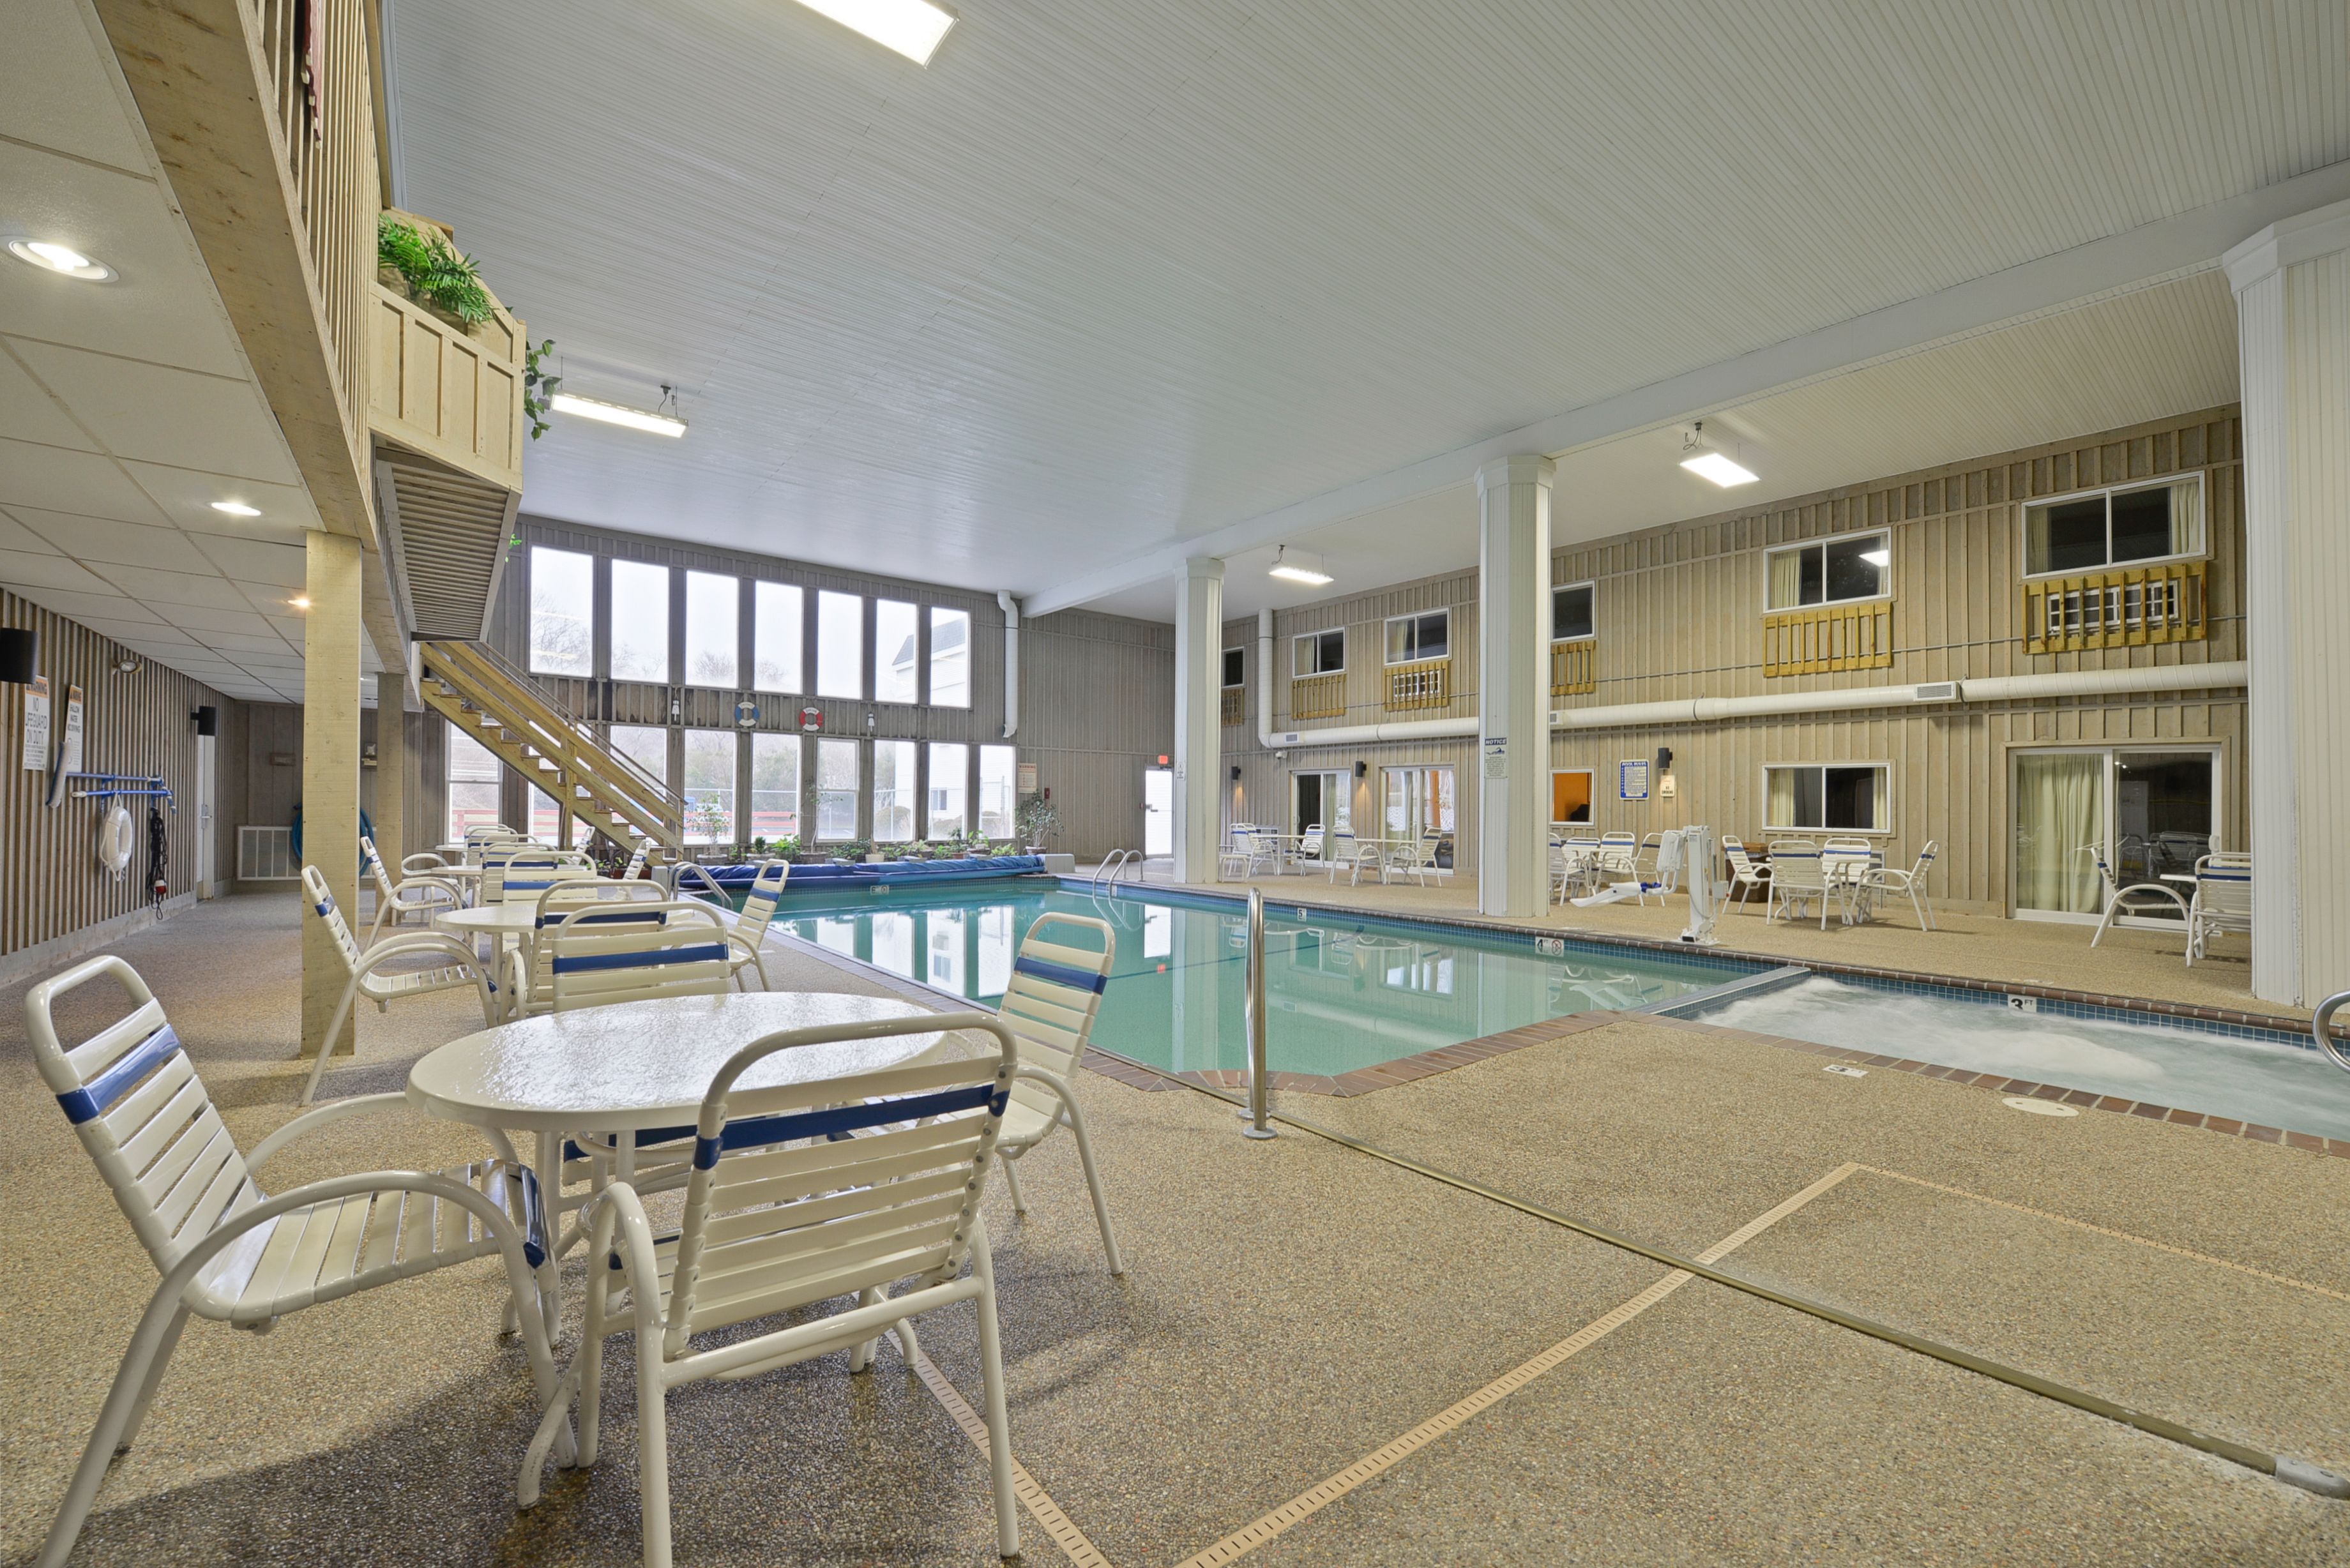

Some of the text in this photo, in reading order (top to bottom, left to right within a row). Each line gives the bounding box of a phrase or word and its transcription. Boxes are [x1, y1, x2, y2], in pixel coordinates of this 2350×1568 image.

[33, 697, 40, 712] NO
[33, 730, 45, 746] DUTY
[2011, 998, 2023, 1010] 3
